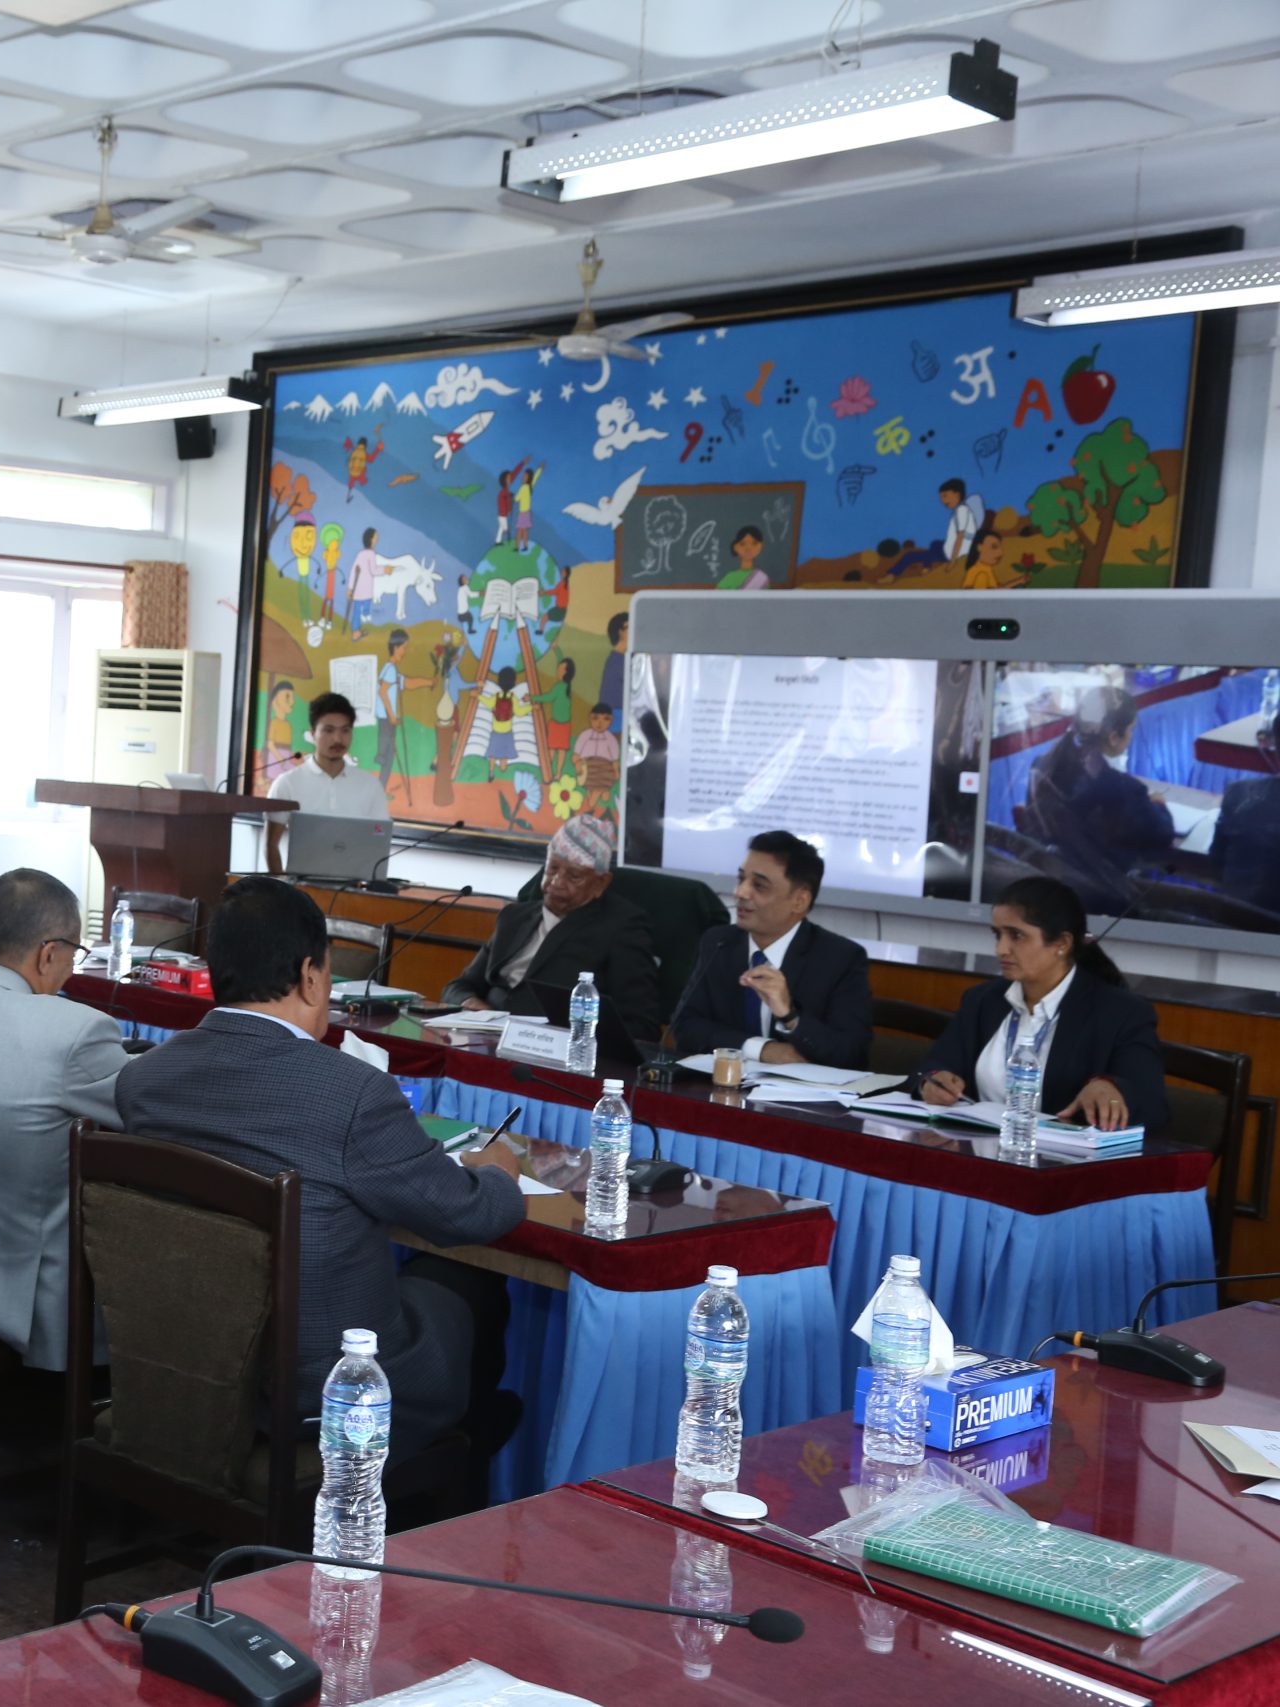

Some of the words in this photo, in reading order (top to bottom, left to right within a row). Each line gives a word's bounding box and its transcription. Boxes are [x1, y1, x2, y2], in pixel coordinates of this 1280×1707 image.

[1013, 378, 1053, 428] A
[140, 965, 181, 984] PREMIUM
[955, 1386, 1033, 1431] PREMIUM
